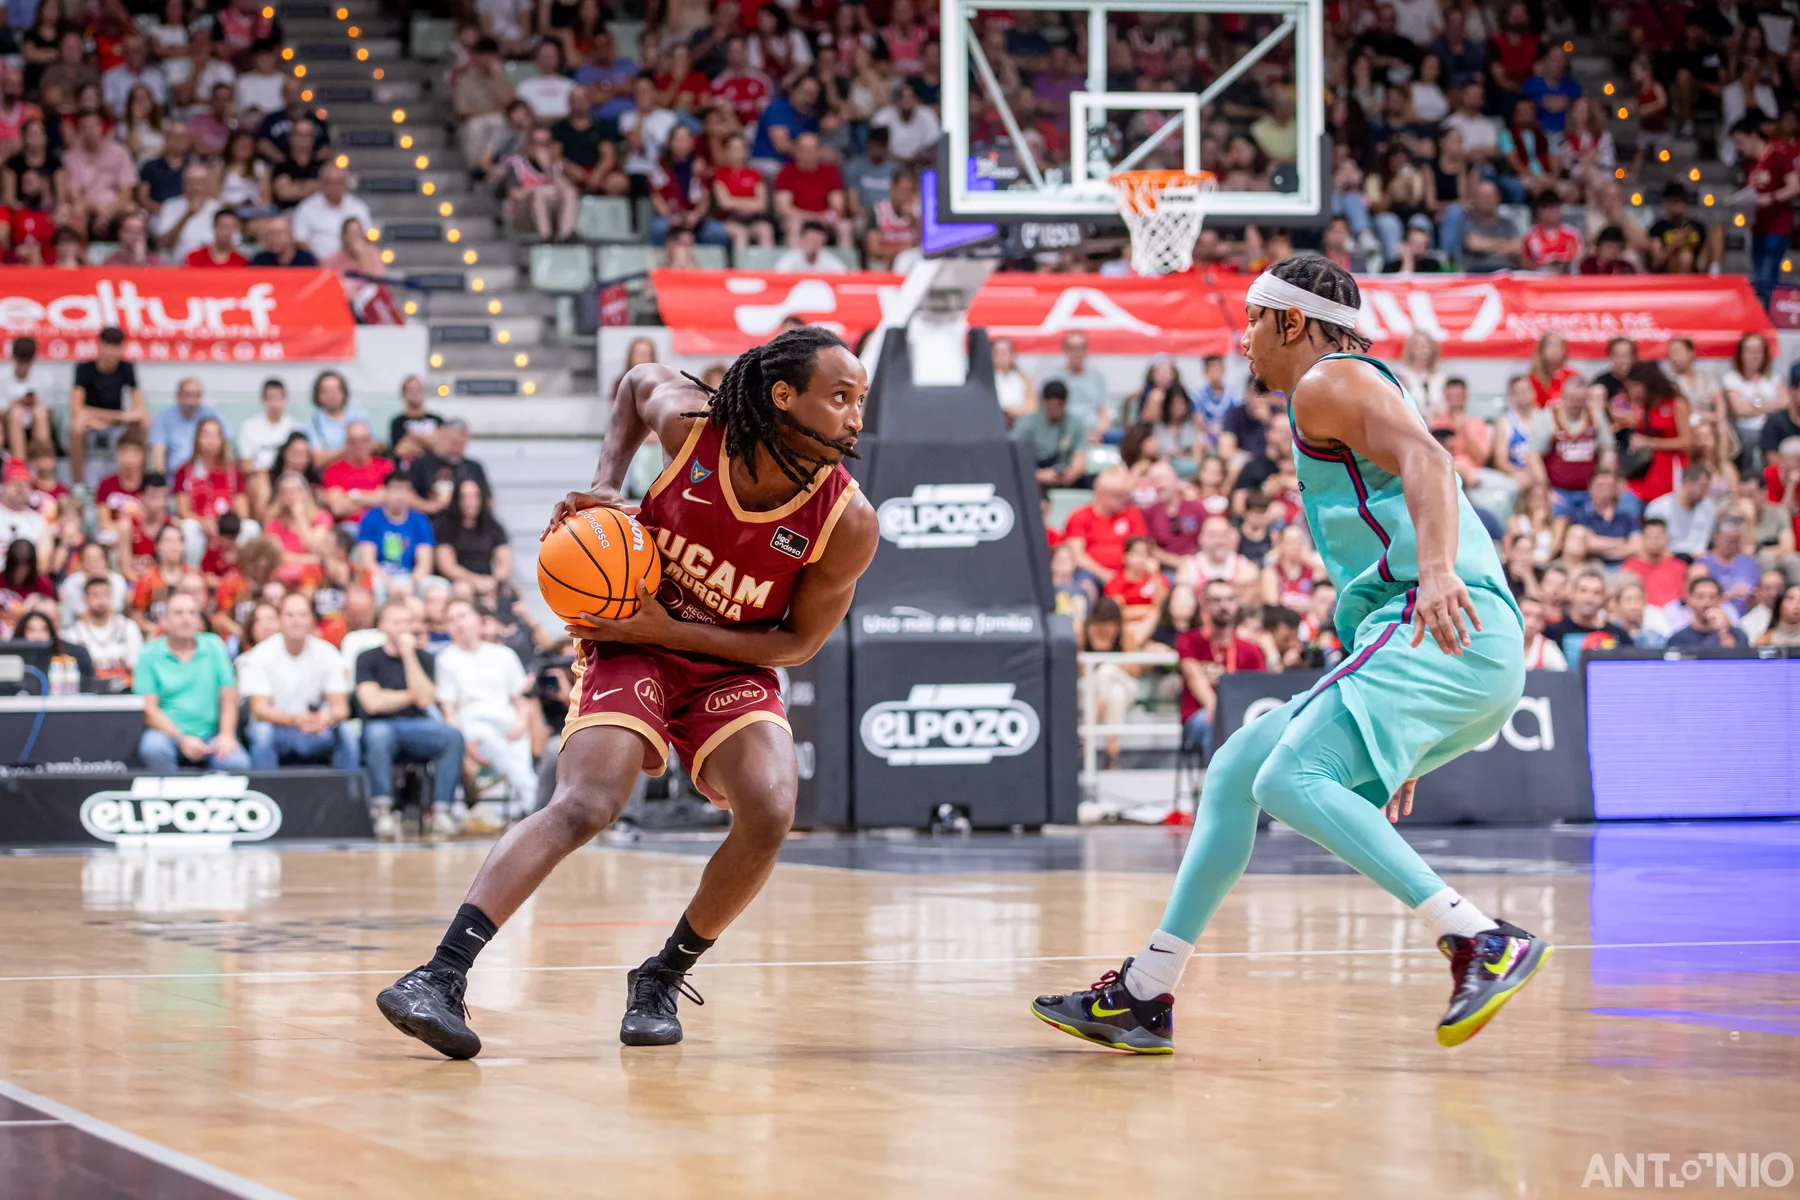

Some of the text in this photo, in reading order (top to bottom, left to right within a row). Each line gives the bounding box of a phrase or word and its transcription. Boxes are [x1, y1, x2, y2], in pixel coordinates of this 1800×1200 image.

[774, 541, 801, 556] endesa
[777, 533, 790, 545] liga
[656, 527, 774, 609] UCAM
[663, 561, 742, 621] MURCIA
[712, 689, 761, 710] Juver
